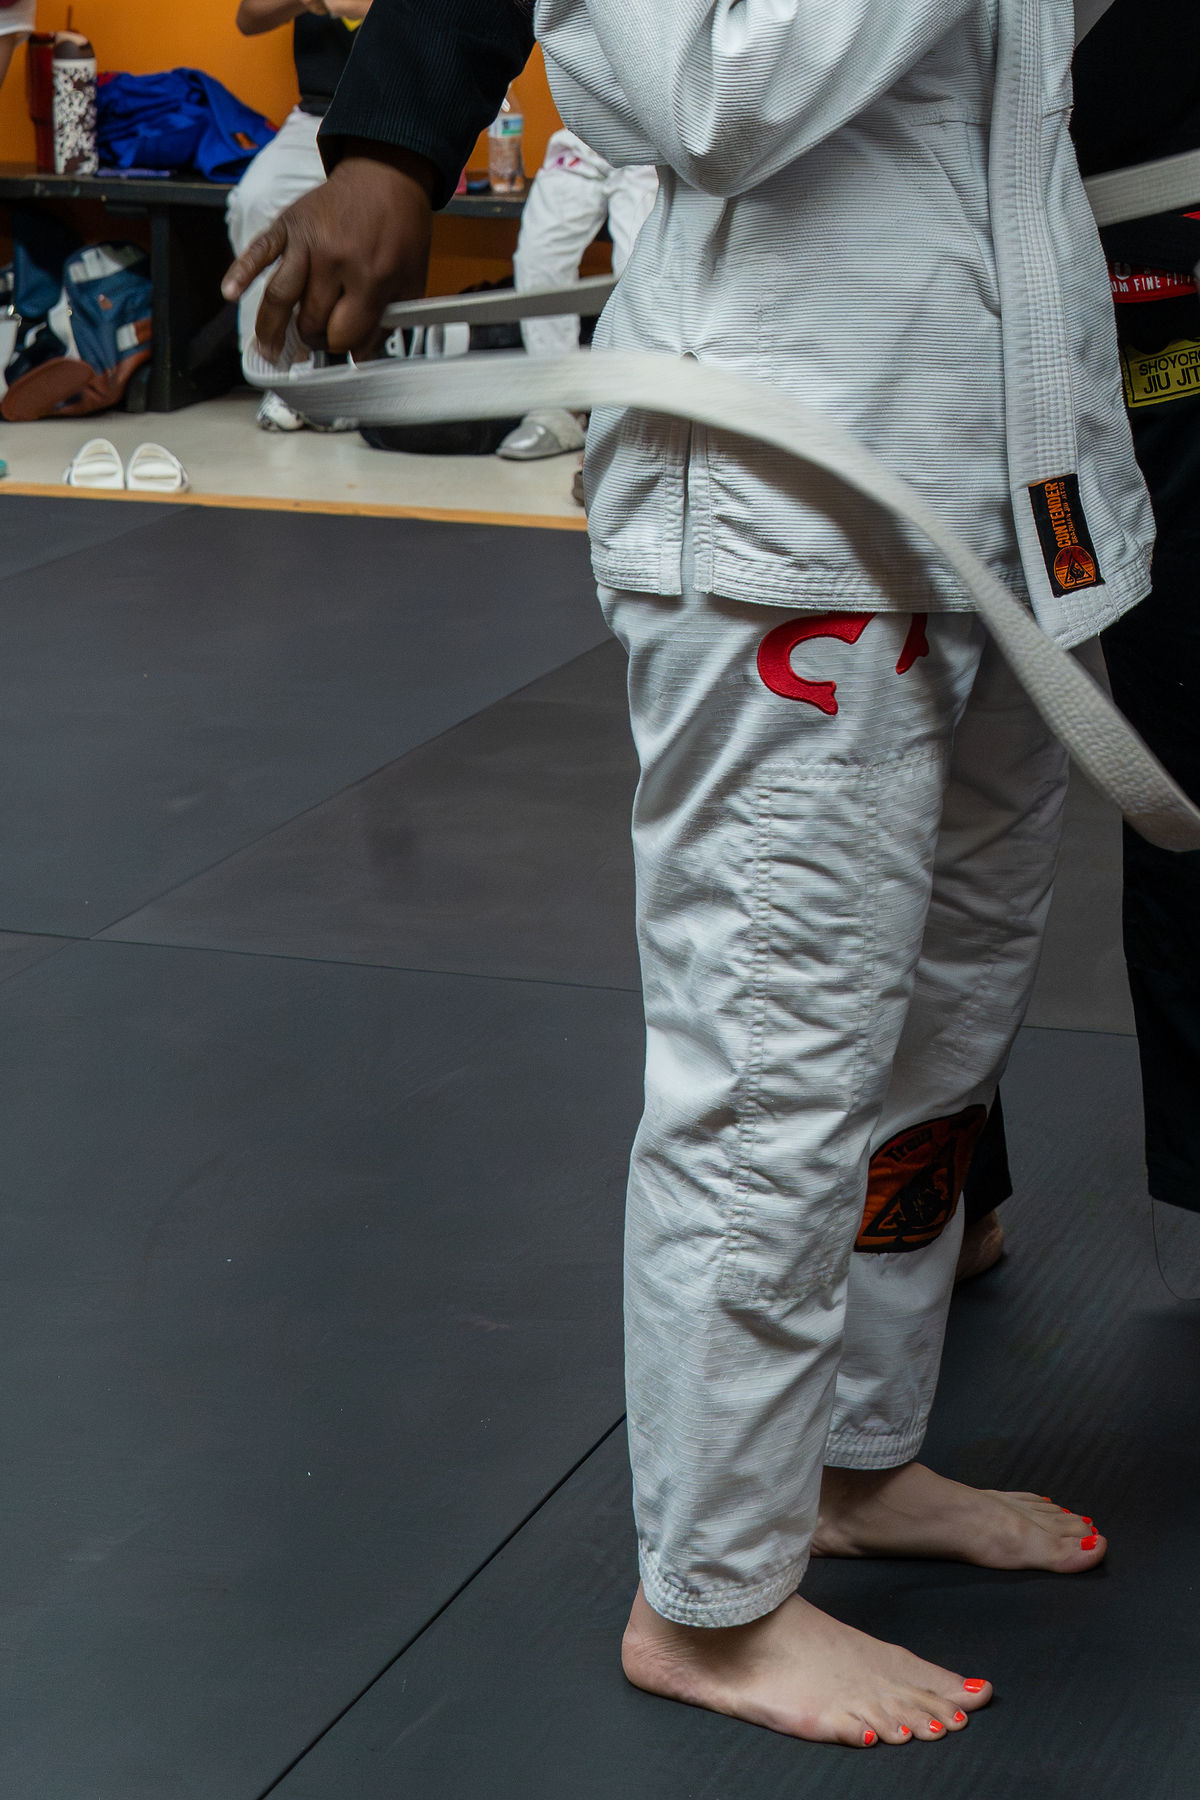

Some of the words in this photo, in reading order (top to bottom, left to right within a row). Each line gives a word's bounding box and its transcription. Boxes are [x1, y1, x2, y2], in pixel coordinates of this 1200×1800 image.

[1133, 275, 1161, 292] FINE
[1144, 372, 1171, 394] JIU
[1044, 482, 1071, 548] CONTENDER
